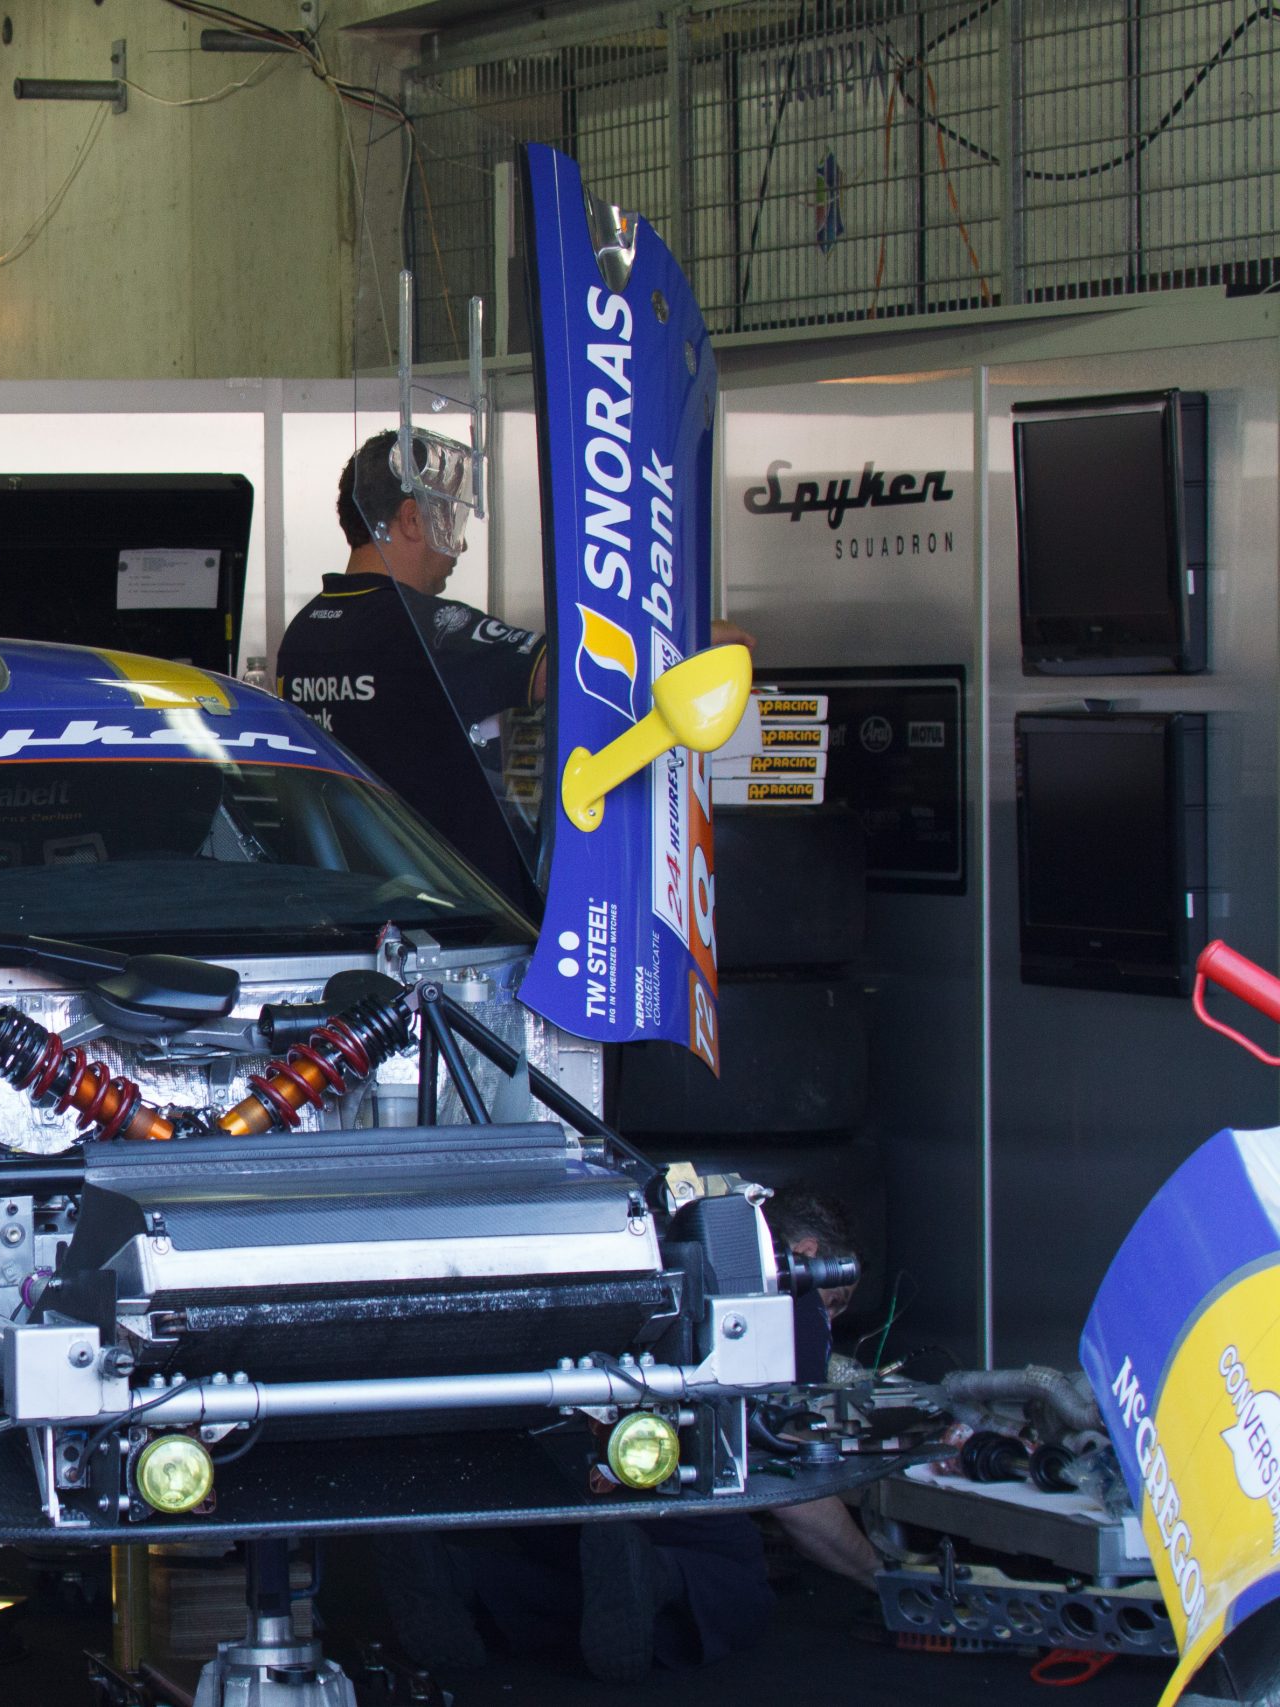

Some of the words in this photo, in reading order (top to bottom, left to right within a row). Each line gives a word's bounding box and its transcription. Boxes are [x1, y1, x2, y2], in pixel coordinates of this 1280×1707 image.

[584, 286, 633, 600] SNORAS
[743, 461, 954, 530] Spyker
[642, 448, 673, 631] bank
[835, 532, 954, 560] SQUADRON
[291, 675, 376, 703] SNORAS
[774, 700, 817, 711] RACING
[778, 730, 821, 742] RACING
[911, 725, 943, 743] MOTUL
[773, 757, 816, 768] RACING
[770, 784, 813, 795] RACING
[668, 849, 683, 925] 24
[587, 901, 609, 977] STEEL
[609, 904, 618, 938] WATCHES
[609, 941, 618, 992] OVERSIZED
[652, 931, 661, 1027] COMMUNICATIE
[586, 980, 607, 1019] TW
[610, 994, 617, 1003] IN
[635, 966, 645, 1029] REPROKA
[644, 969, 653, 1021] VISUELE
